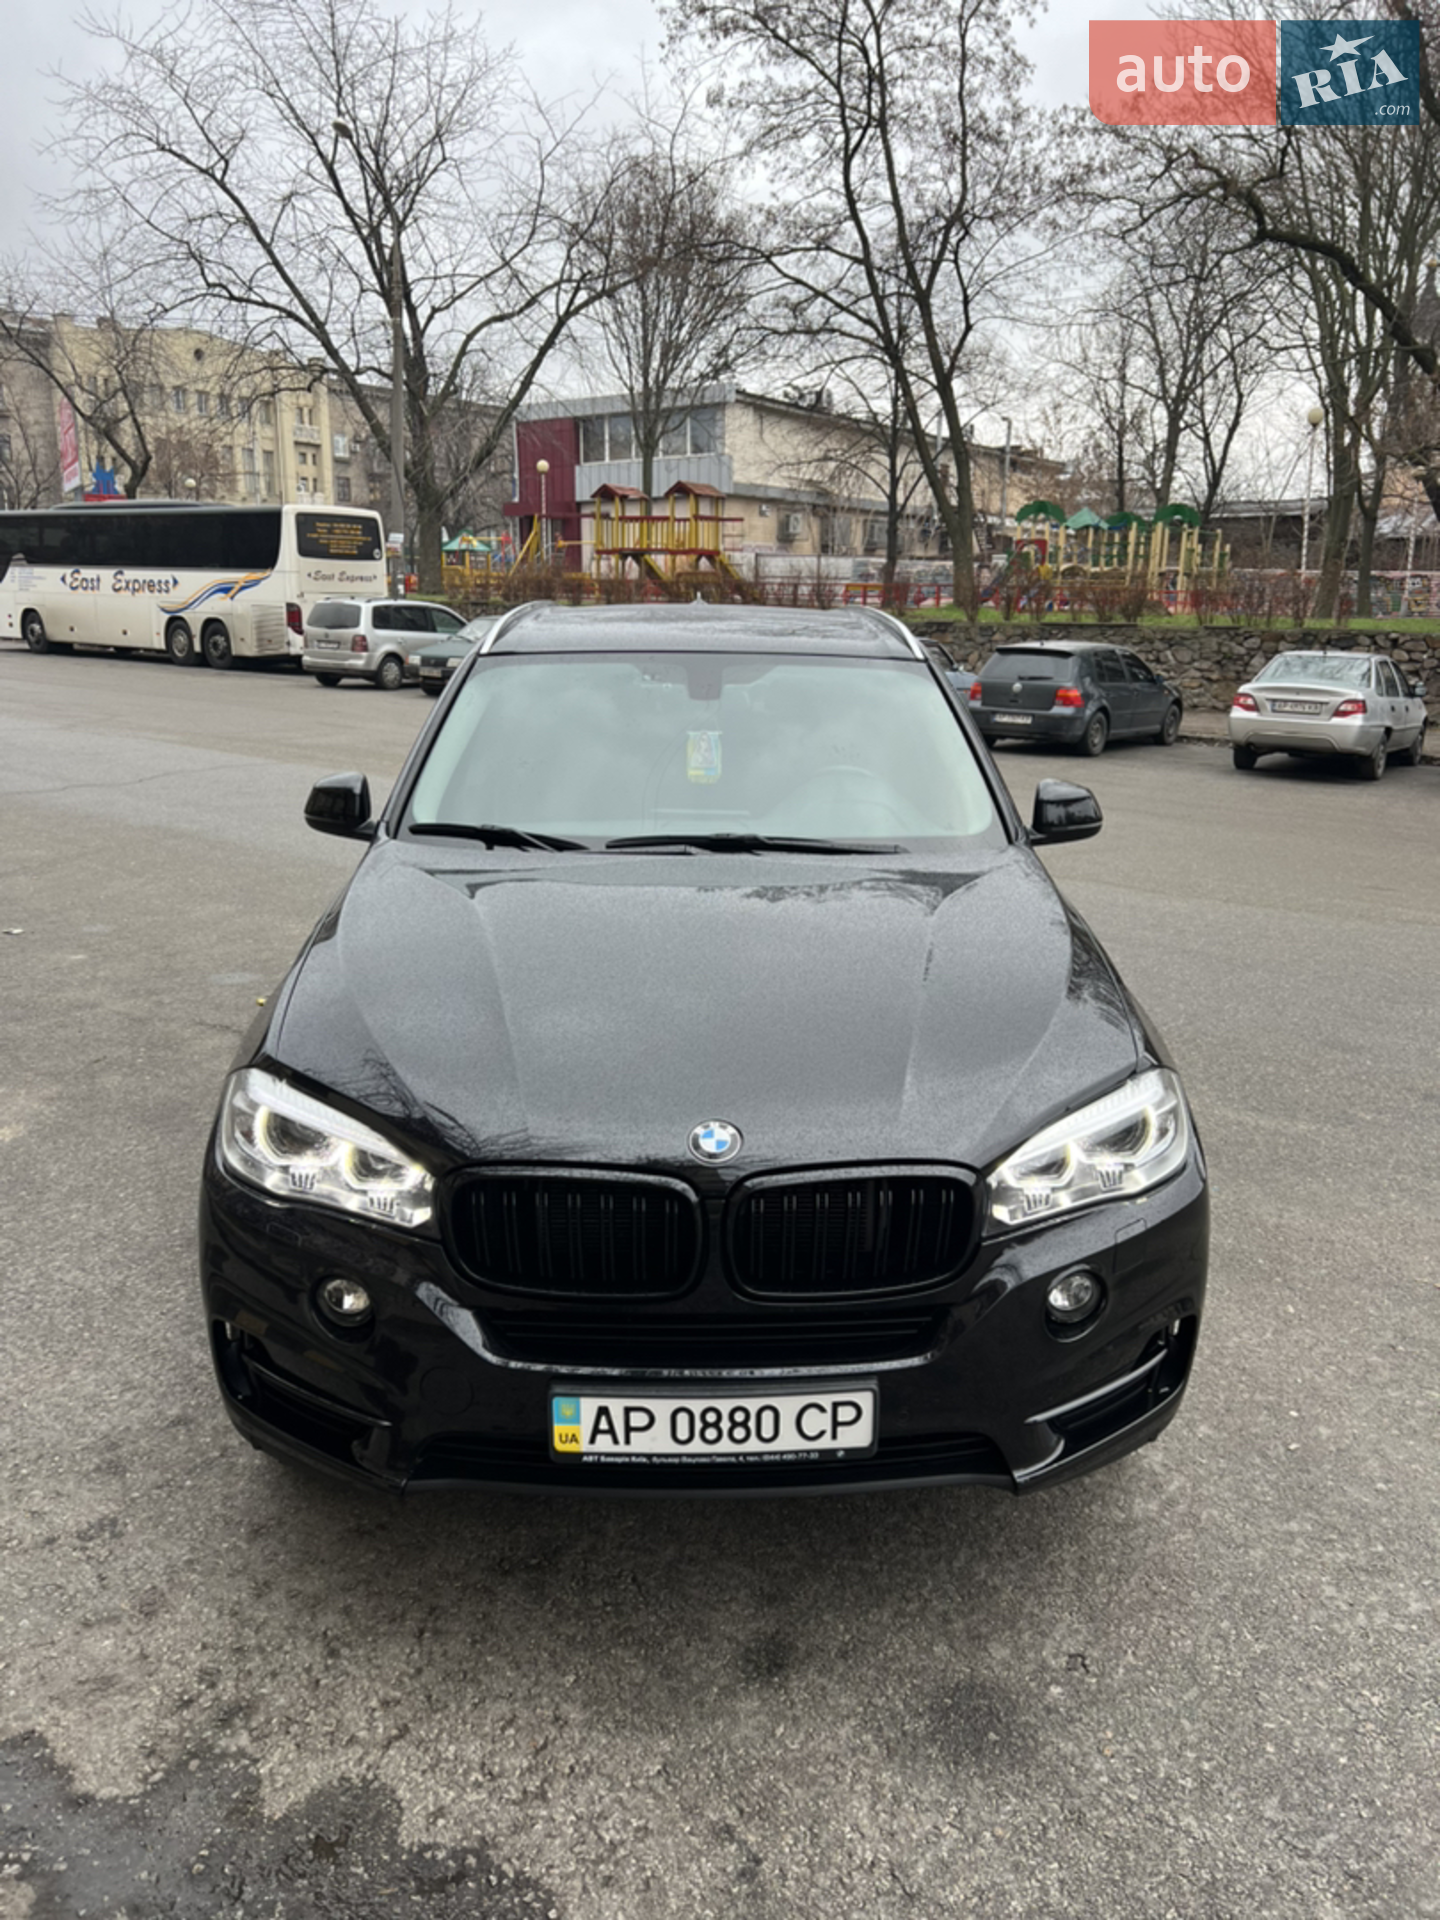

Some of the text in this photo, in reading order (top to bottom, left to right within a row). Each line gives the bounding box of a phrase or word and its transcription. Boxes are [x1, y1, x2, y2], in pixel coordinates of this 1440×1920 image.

[69, 569, 101, 592] East
[112, 569, 171, 597] Express
[588, 1401, 863, 1445] AP 0880 CP
[559, 1433, 579, 1444] UA
